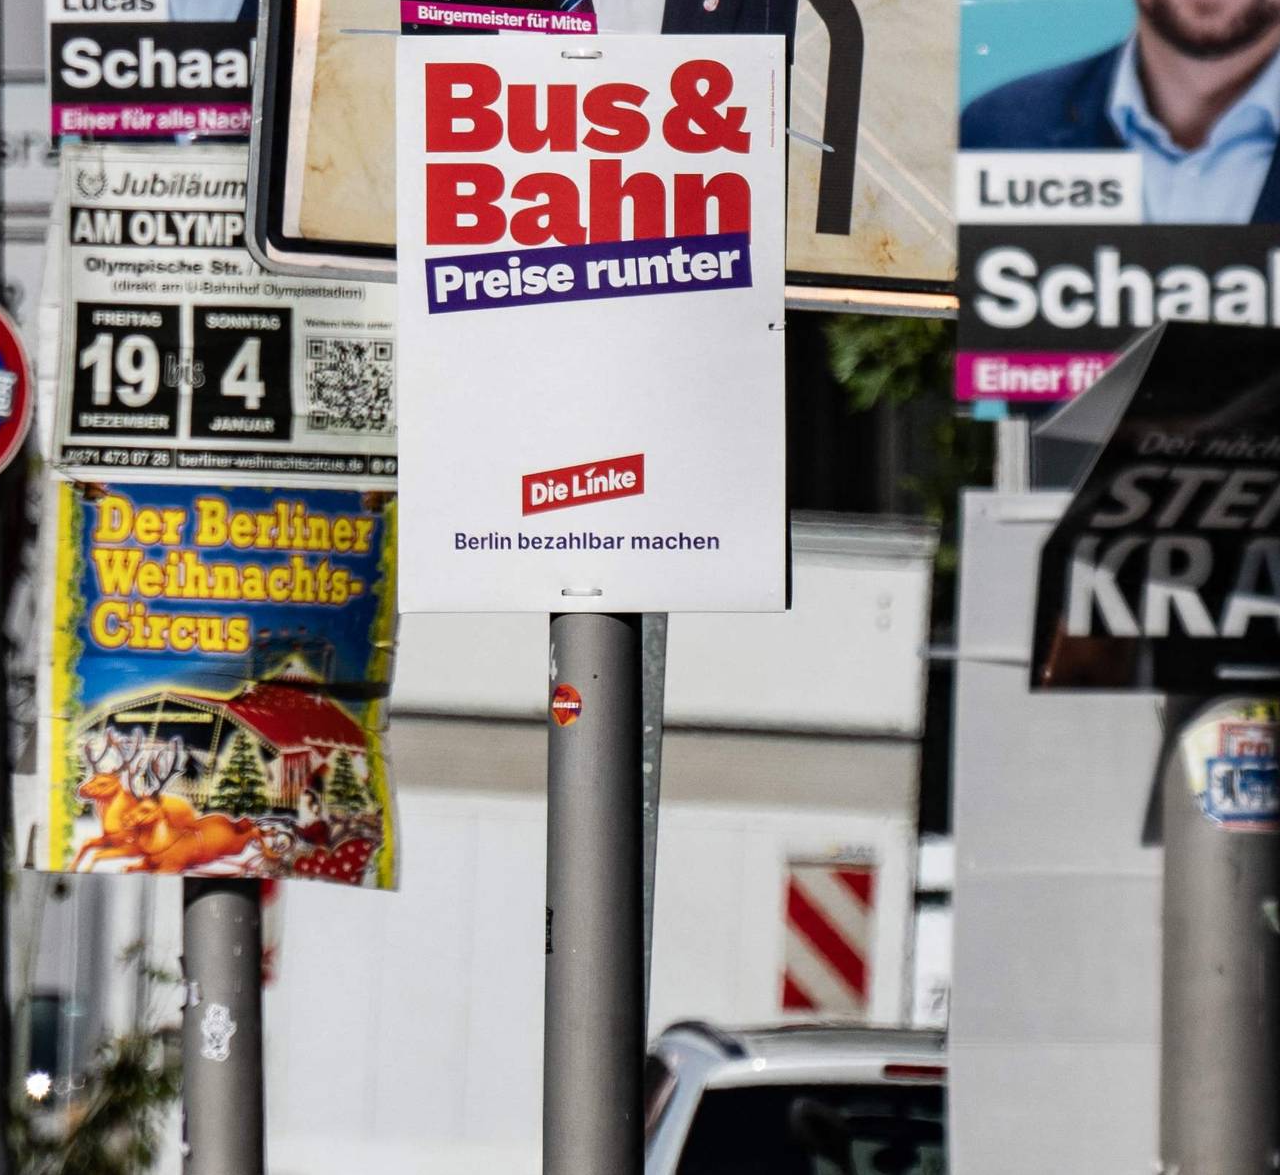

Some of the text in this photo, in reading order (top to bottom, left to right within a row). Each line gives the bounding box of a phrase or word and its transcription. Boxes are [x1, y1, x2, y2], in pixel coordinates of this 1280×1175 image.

[417, 5, 592, 32] Bürgermeister für Mitte
[60, 107, 119, 130] Einer
[121, 106, 154, 130] für
[157, 108, 196, 129] alle
[424, 62, 651, 155] Bus
[662, 58, 752, 155] &
[425, 158, 752, 247] Bahn
[976, 169, 1125, 209] Lucas
[74, 210, 122, 244] AM
[84, 257, 202, 278] Olympische
[211, 260, 243, 275] Str.
[433, 246, 741, 305] Preise runter
[92, 311, 282, 330] FREITAG SONNTAG
[79, 333, 160, 407] 19
[219, 337, 266, 411] 4
[973, 357, 1062, 393] Einer
[79, 413, 276, 433] DEZEMBER JANUAR
[1137, 432, 1193, 457] Der
[530, 467, 636, 508] Die Linke
[94, 494, 375, 554] Der Berliner
[454, 532, 720, 552] Berlin bezahlbar machen
[91, 548, 365, 606] Weihnachts-
[91, 599, 251, 653] Circus
